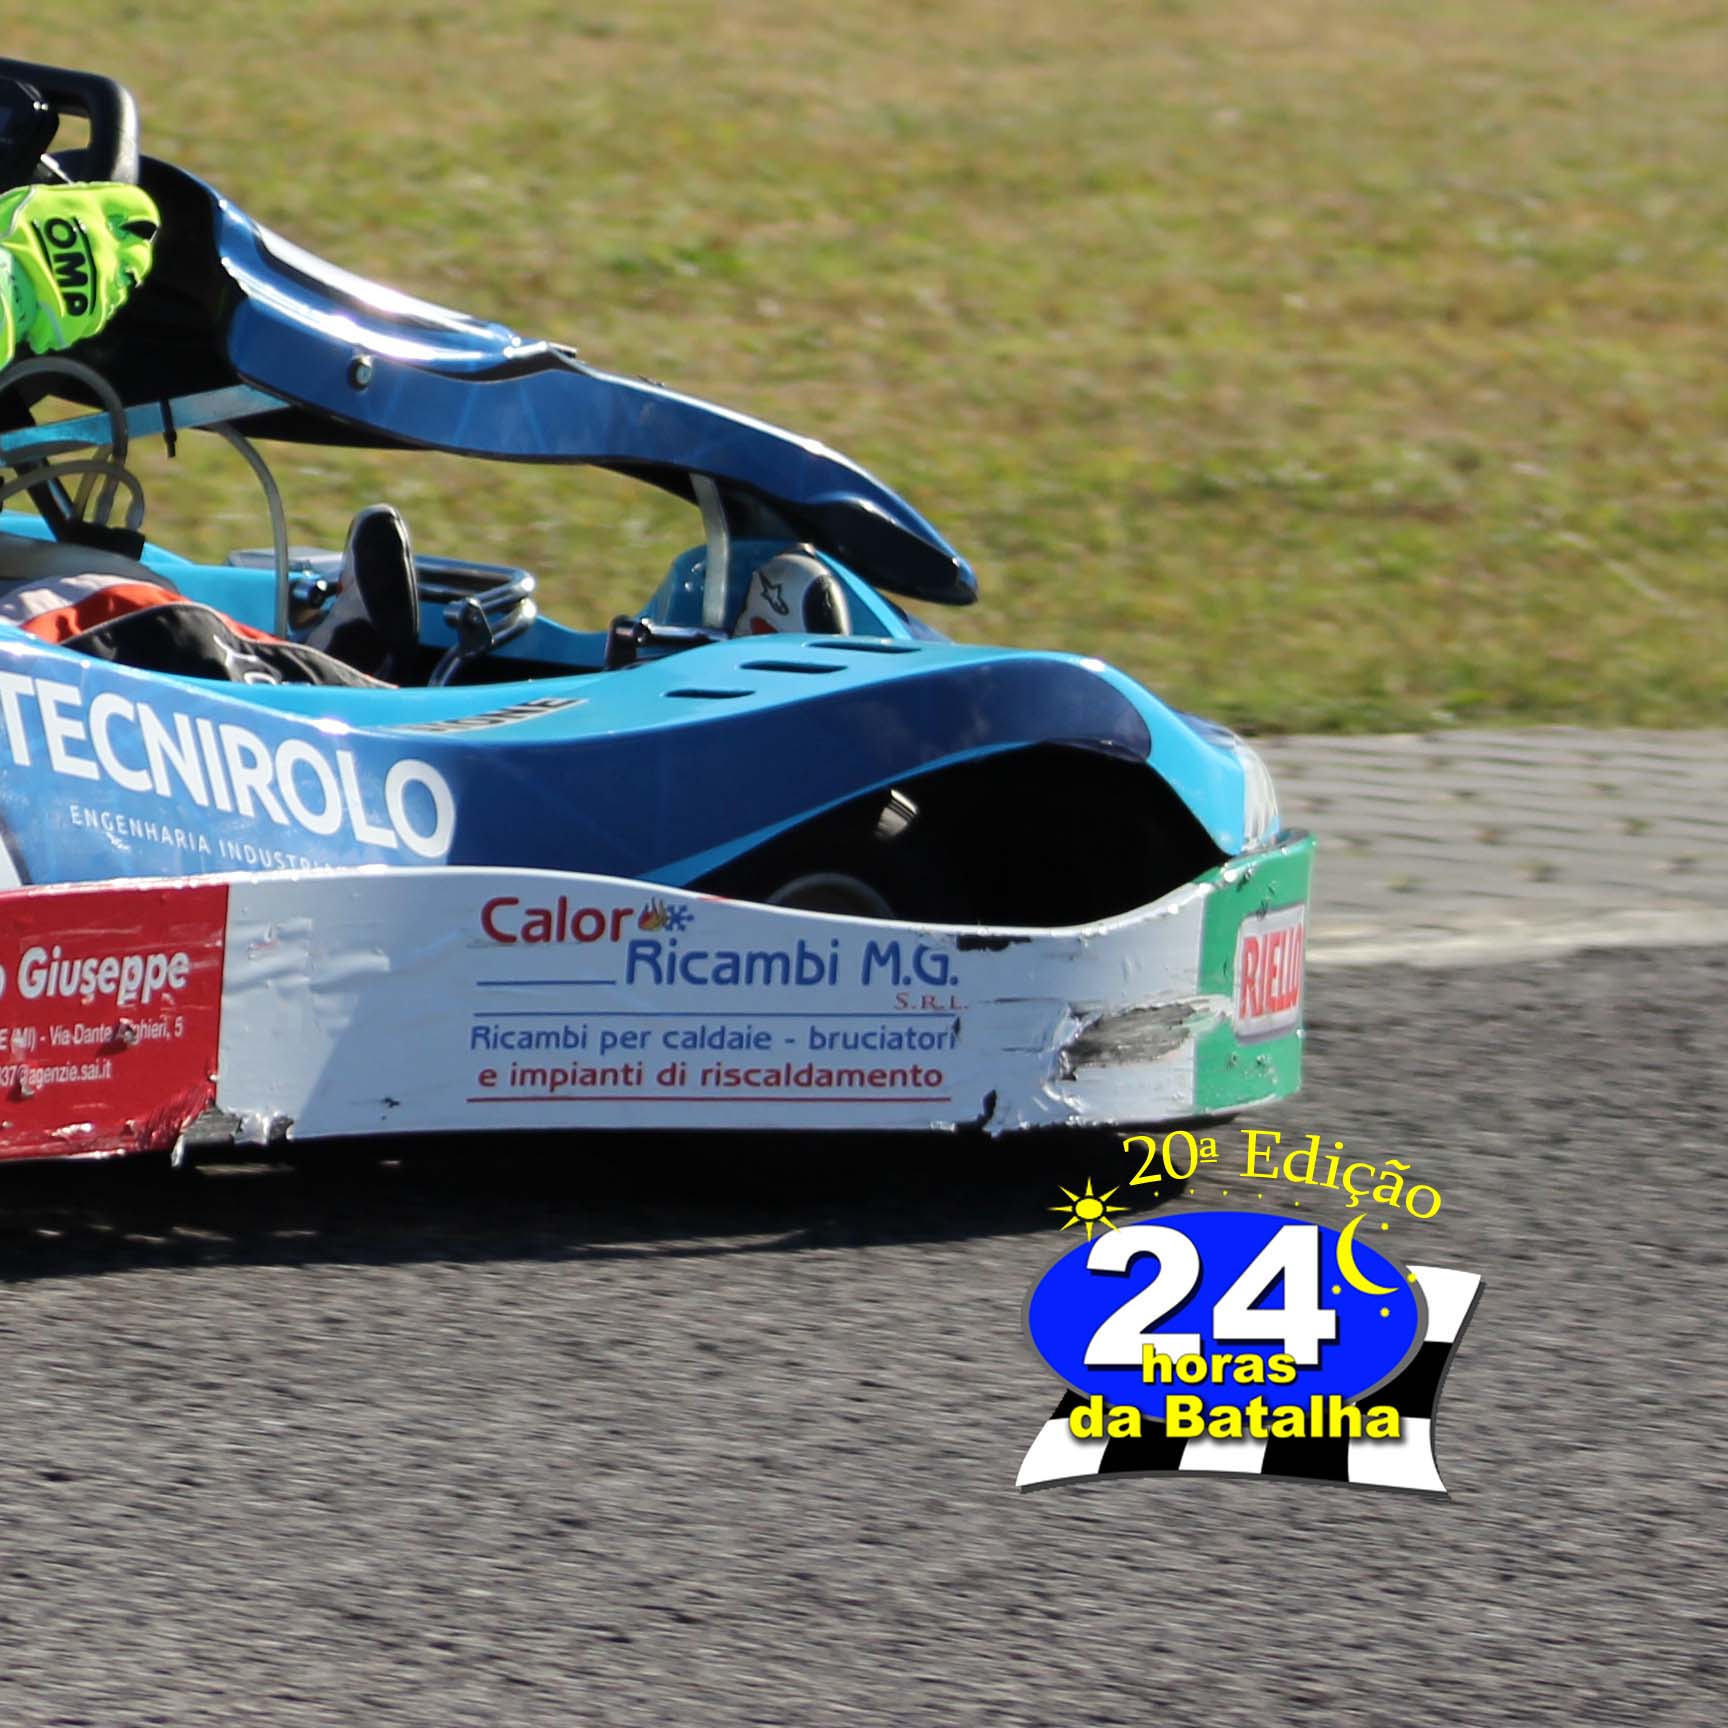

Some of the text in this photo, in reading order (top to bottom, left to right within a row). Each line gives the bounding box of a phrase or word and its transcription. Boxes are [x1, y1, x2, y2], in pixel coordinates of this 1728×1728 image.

[44, 217, 89, 317] OMP
[69, 804, 210, 856] ENGENHARIA
[480, 895, 634, 944] Calor
[17, 945, 191, 1008] Giuseppe
[625, 938, 960, 988] Ricambi M.G.
[894, 991, 970, 1011] S.R.L.
[49, 1025, 71, 1047] Via
[72, 1022, 114, 1046] Dante
[174, 1016, 185, 1038] 5
[470, 1023, 589, 1052] Ricambi
[600, 1027, 652, 1056] per
[663, 1024, 773, 1052] caldaie
[808, 1024, 958, 1052] bruciatori
[478, 1062, 945, 1093] e impianti di riscaldamento
